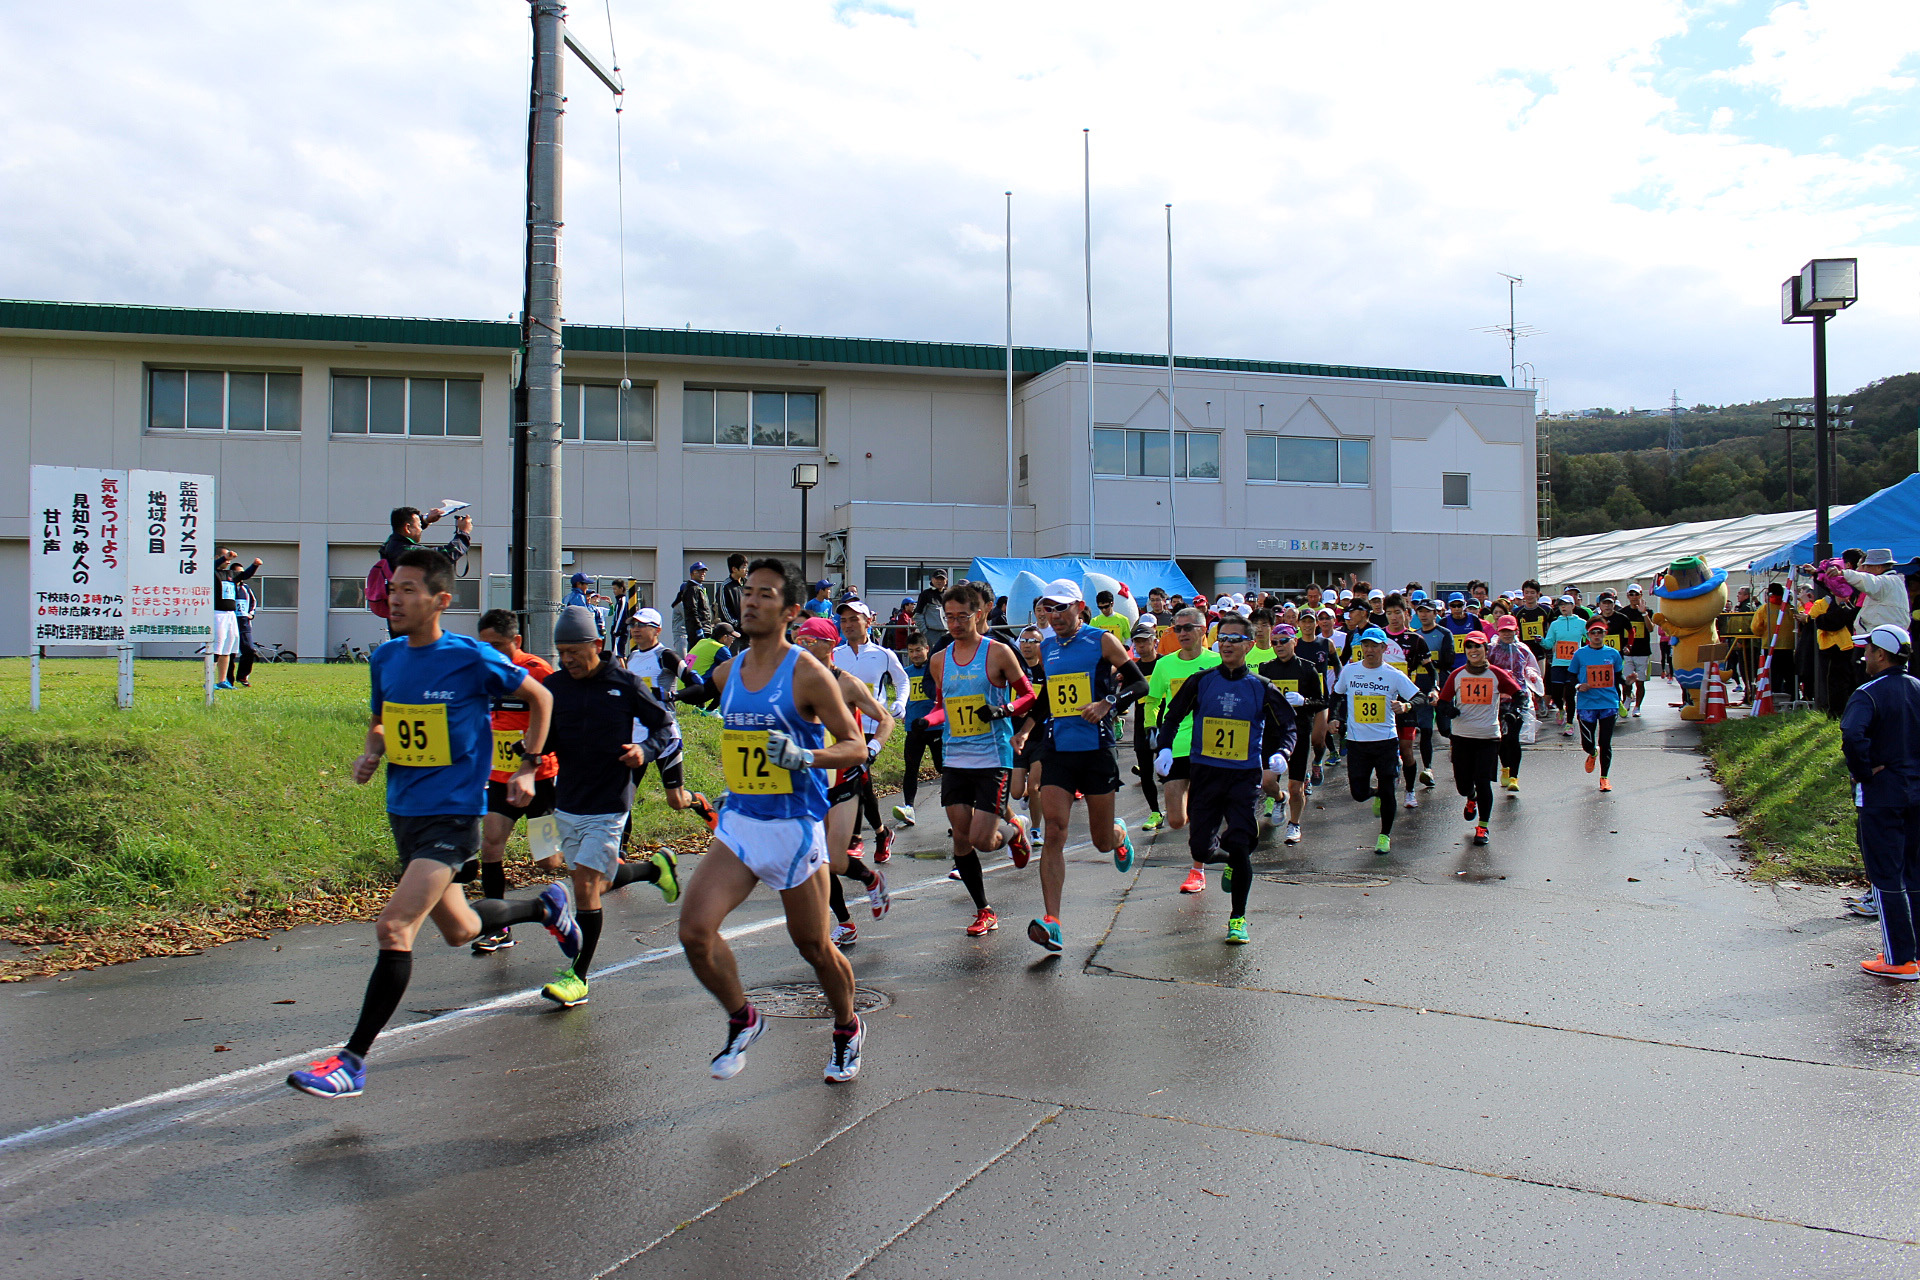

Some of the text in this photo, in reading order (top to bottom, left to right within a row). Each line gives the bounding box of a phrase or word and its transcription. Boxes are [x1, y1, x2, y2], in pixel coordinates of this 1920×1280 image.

[43, 508, 62, 555] 甘い声
[101, 478, 119, 569] 気をつけよう
[147, 490, 168, 555] 地域の目
[179, 481, 199, 575] 監視カメラは
[72, 493, 90, 585] 見知らぬ人の
[1321, 541, 1374, 552] 海洋センター
[36, 591, 124, 605] 下校時の3時から
[132, 597, 211, 607] にまきこまれない
[37, 606, 123, 618] 6時は危険タイム
[1527, 626, 1538, 635] 83
[1560, 645, 1575, 655] 112
[1591, 670, 1610, 682] 118
[1058, 683, 1078, 705] 53
[1466, 684, 1487, 698] 141
[957, 705, 974, 726] 17
[1362, 702, 1378, 716] 38
[398, 719, 427, 750] 95
[1215, 728, 1235, 749] 21
[497, 740, 514, 761] 99
[737, 746, 770, 777] 72
